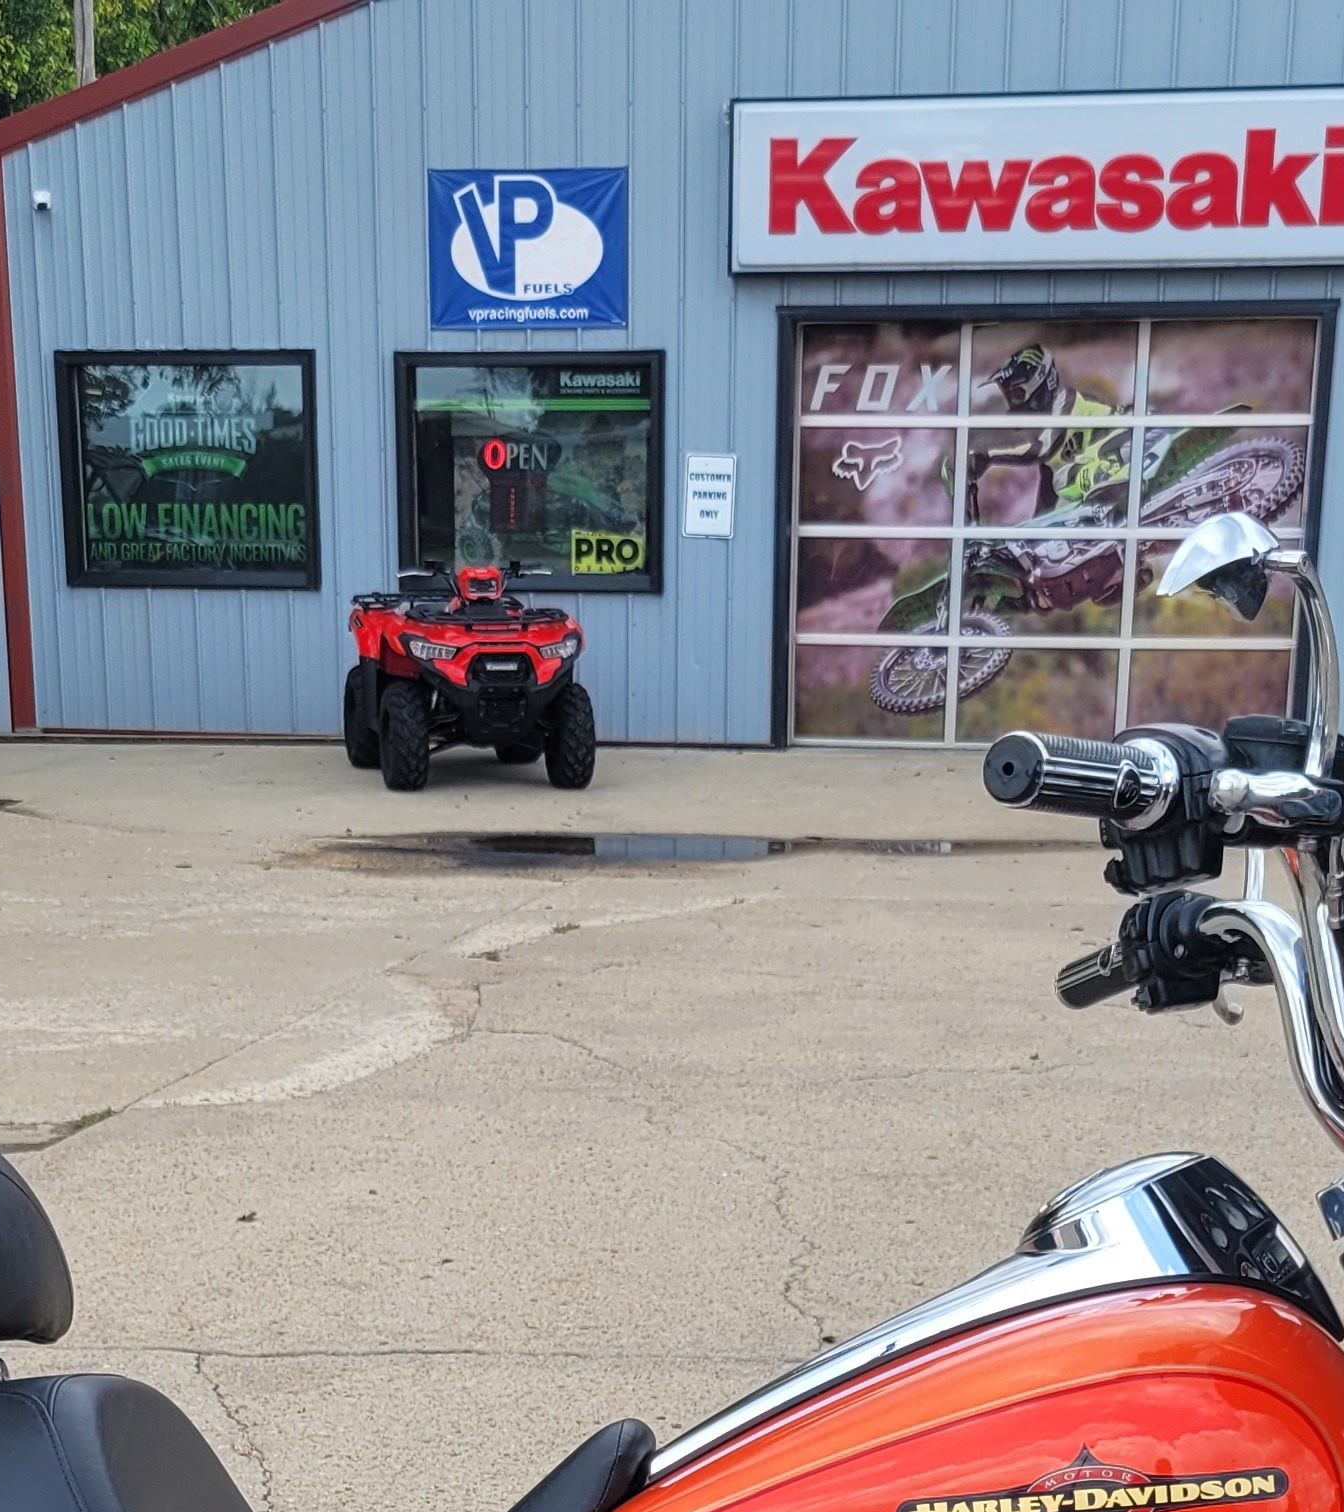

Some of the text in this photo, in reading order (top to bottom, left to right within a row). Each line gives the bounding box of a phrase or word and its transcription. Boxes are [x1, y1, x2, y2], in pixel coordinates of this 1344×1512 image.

[454, 175, 557, 297] VP
[523, 283, 573, 294] FUELS
[467, 305, 589, 323] vpracingfuels.com
[559, 370, 641, 388] Kawasaki
[810, 362, 957, 413] FOX
[195, 455, 225, 468] EVENT
[482, 439, 549, 471] OPEN
[689, 472, 732, 483] CUSTOMER
[692, 490, 727, 501] PARKING
[86, 502, 307, 541] LOW FINANCING
[699, 509, 720, 520] ONLY
[90, 543, 307, 562] AND GREAT FACTORY INCENTIVES
[573, 537, 641, 565] PRO
[1043, 1468, 1134, 1489] MOTOR
